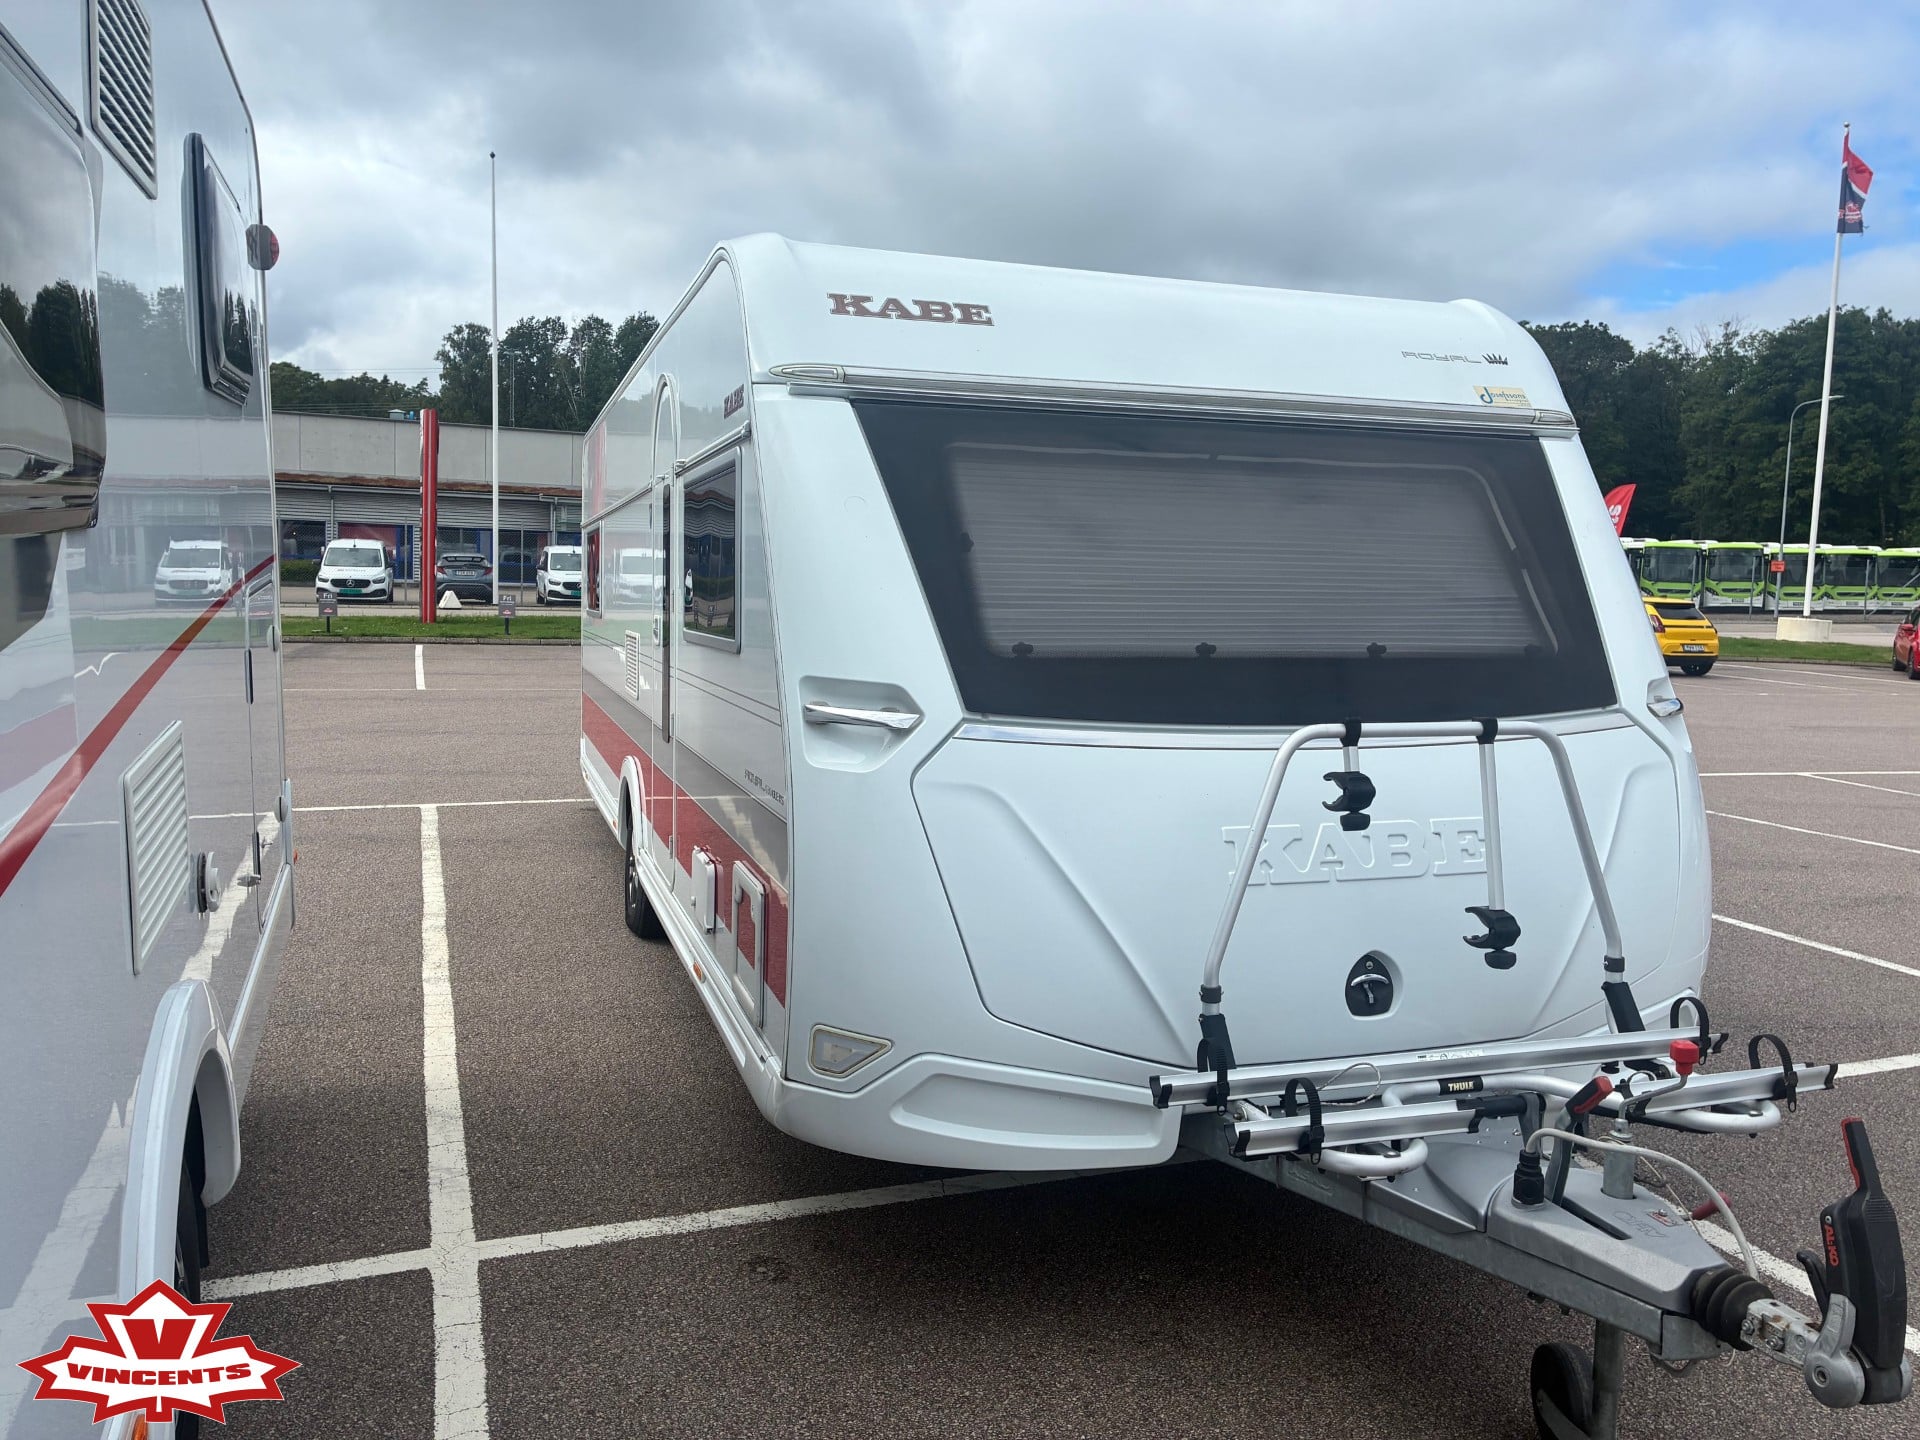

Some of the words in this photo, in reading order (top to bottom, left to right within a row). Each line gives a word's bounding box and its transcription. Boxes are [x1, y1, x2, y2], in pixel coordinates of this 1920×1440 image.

[826, 291, 995, 327] KABE
[1220, 815, 1489, 887] KABE
[1448, 1081, 1474, 1092] THULE
